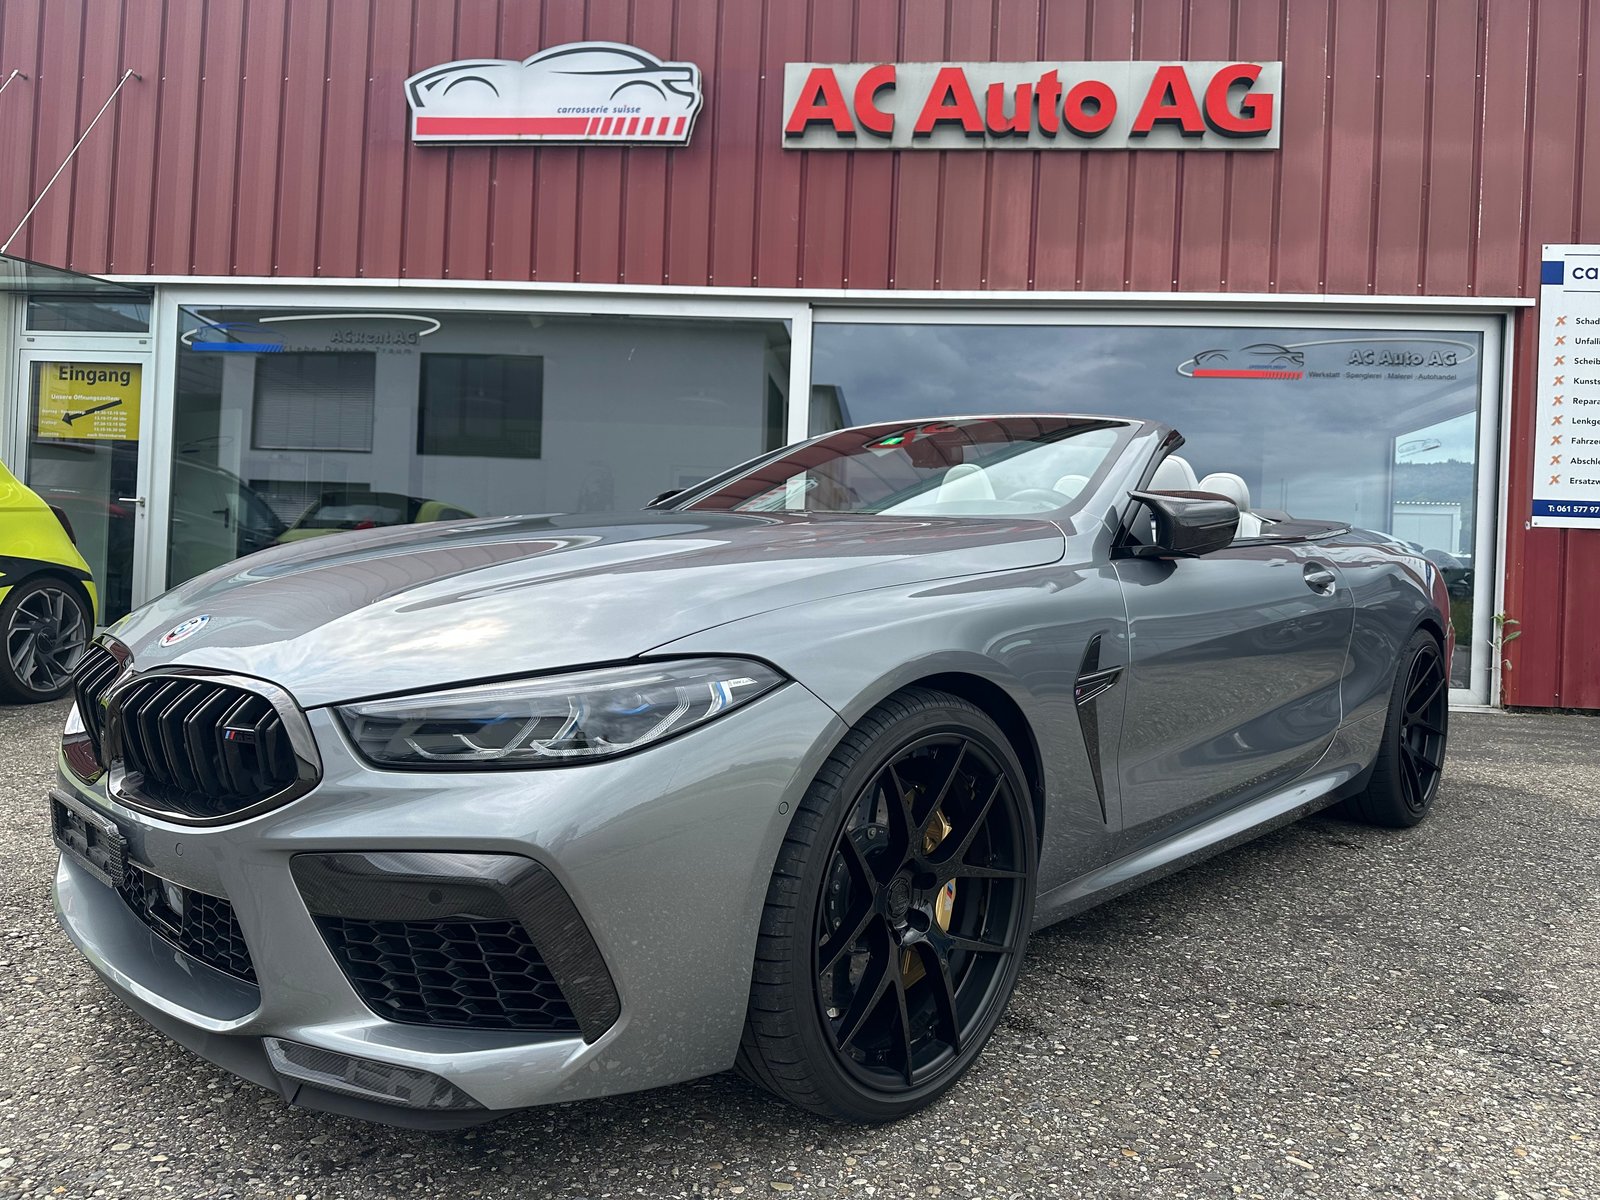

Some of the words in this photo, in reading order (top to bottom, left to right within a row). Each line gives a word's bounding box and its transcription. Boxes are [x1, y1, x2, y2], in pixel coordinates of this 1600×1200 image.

[785, 65, 896, 138] AC
[913, 66, 1118, 138] Auto
[1129, 63, 1274, 138] AG
[557, 105, 608, 114] carrosserie
[1572, 267, 1599, 280] ca
[1346, 349, 1375, 366] AC
[1376, 349, 1424, 367] Auto
[1426, 350, 1458, 367] AG
[58, 366, 131, 386] Eingang
[1345, 372, 1382, 380] Spenglerei
[1571, 437, 1600, 445] Fahrze
[1573, 505, 1588, 513] 577
